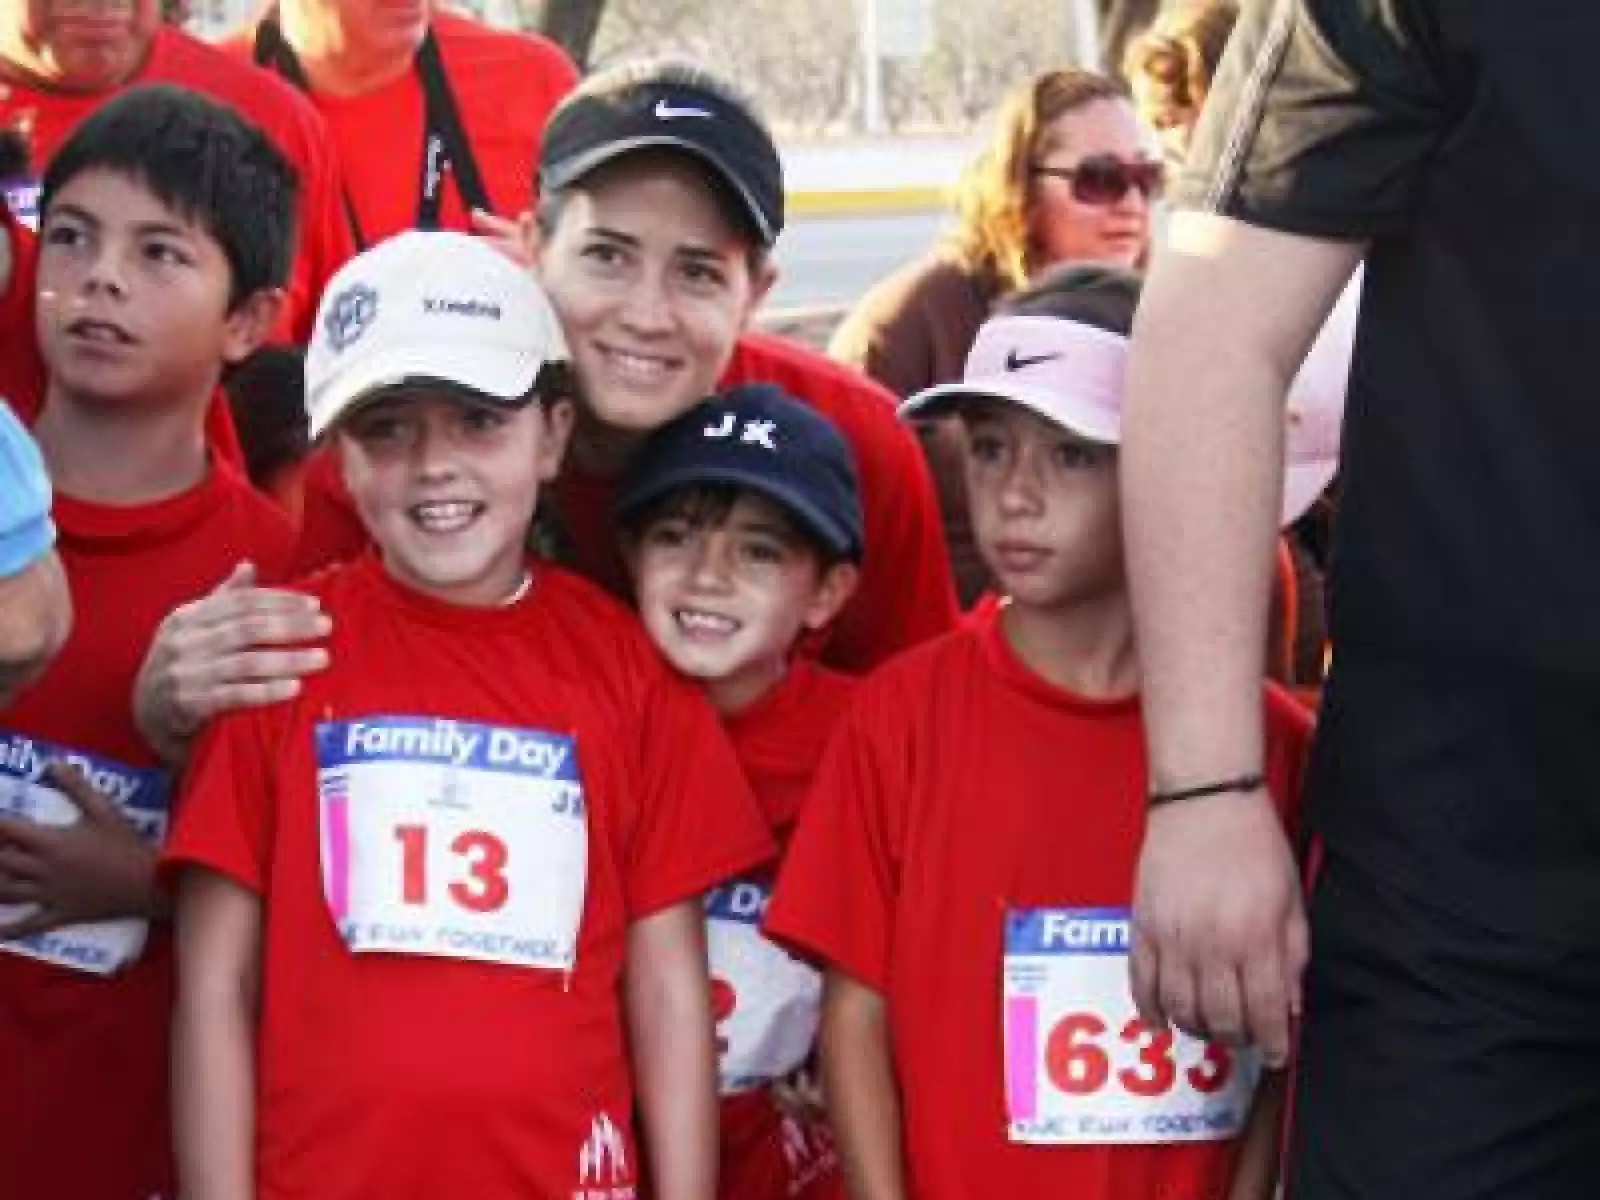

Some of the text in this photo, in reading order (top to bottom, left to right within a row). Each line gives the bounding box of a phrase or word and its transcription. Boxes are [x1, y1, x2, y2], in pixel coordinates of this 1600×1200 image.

[0, 734, 51, 783] ily
[346, 720, 566, 778] Family Day
[395, 825, 509, 912] 13
[1042, 913, 1130, 948] Fam
